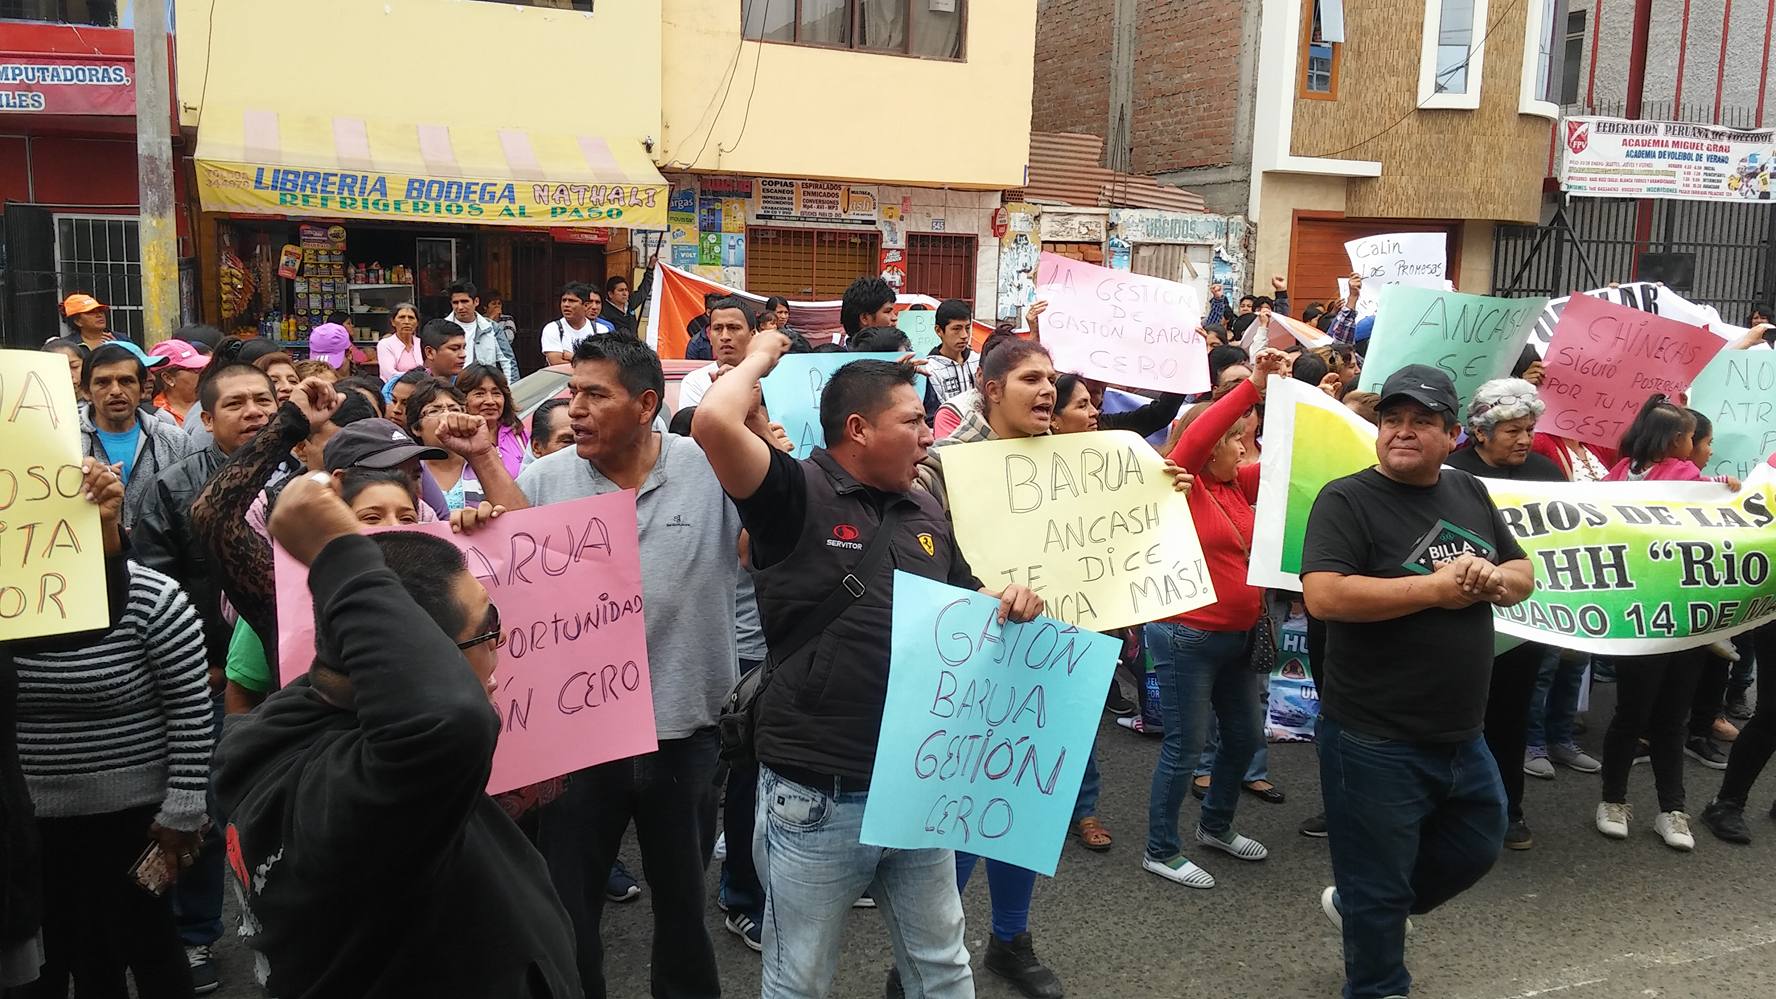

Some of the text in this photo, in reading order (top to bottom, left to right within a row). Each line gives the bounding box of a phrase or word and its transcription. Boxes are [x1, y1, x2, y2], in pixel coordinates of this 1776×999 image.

[1573, 140, 1586, 149] FPV
[1621, 138, 1669, 149] ACADEMIA
[1671, 141, 1704, 152] MIGUEL
[1625, 150, 1729, 165] ACADEMIA DE VOLEIBOL DE VERANO
[253, 167, 657, 208] LIBRERIA BODEGA NATHALI
[761, 180, 794, 188] COPIAS
[801, 182, 842, 191] ESPIRALADOS
[279, 192, 624, 220] REFRIGERIOS AL PASO
[932, 222, 944, 230] 545
[1047, 264, 1077, 296] LA
[1111, 304, 1144, 323] DE
[1143, 326, 1201, 345] BARUA
[1437, 353, 1487, 381] SE
[1547, 378, 1641, 414] POR TU M
[1004, 446, 1144, 514] BARUA
[1612, 505, 1682, 527] DE
[1688, 493, 1774, 529] LAS
[1043, 502, 1160, 553] ANCASH
[826, 538, 863, 551] SERVITOR
[1428, 540, 1476, 560] BILLA
[1626, 603, 1677, 637] 14
[1689, 601, 1740, 634] DE
[557, 660, 640, 715] CERO
